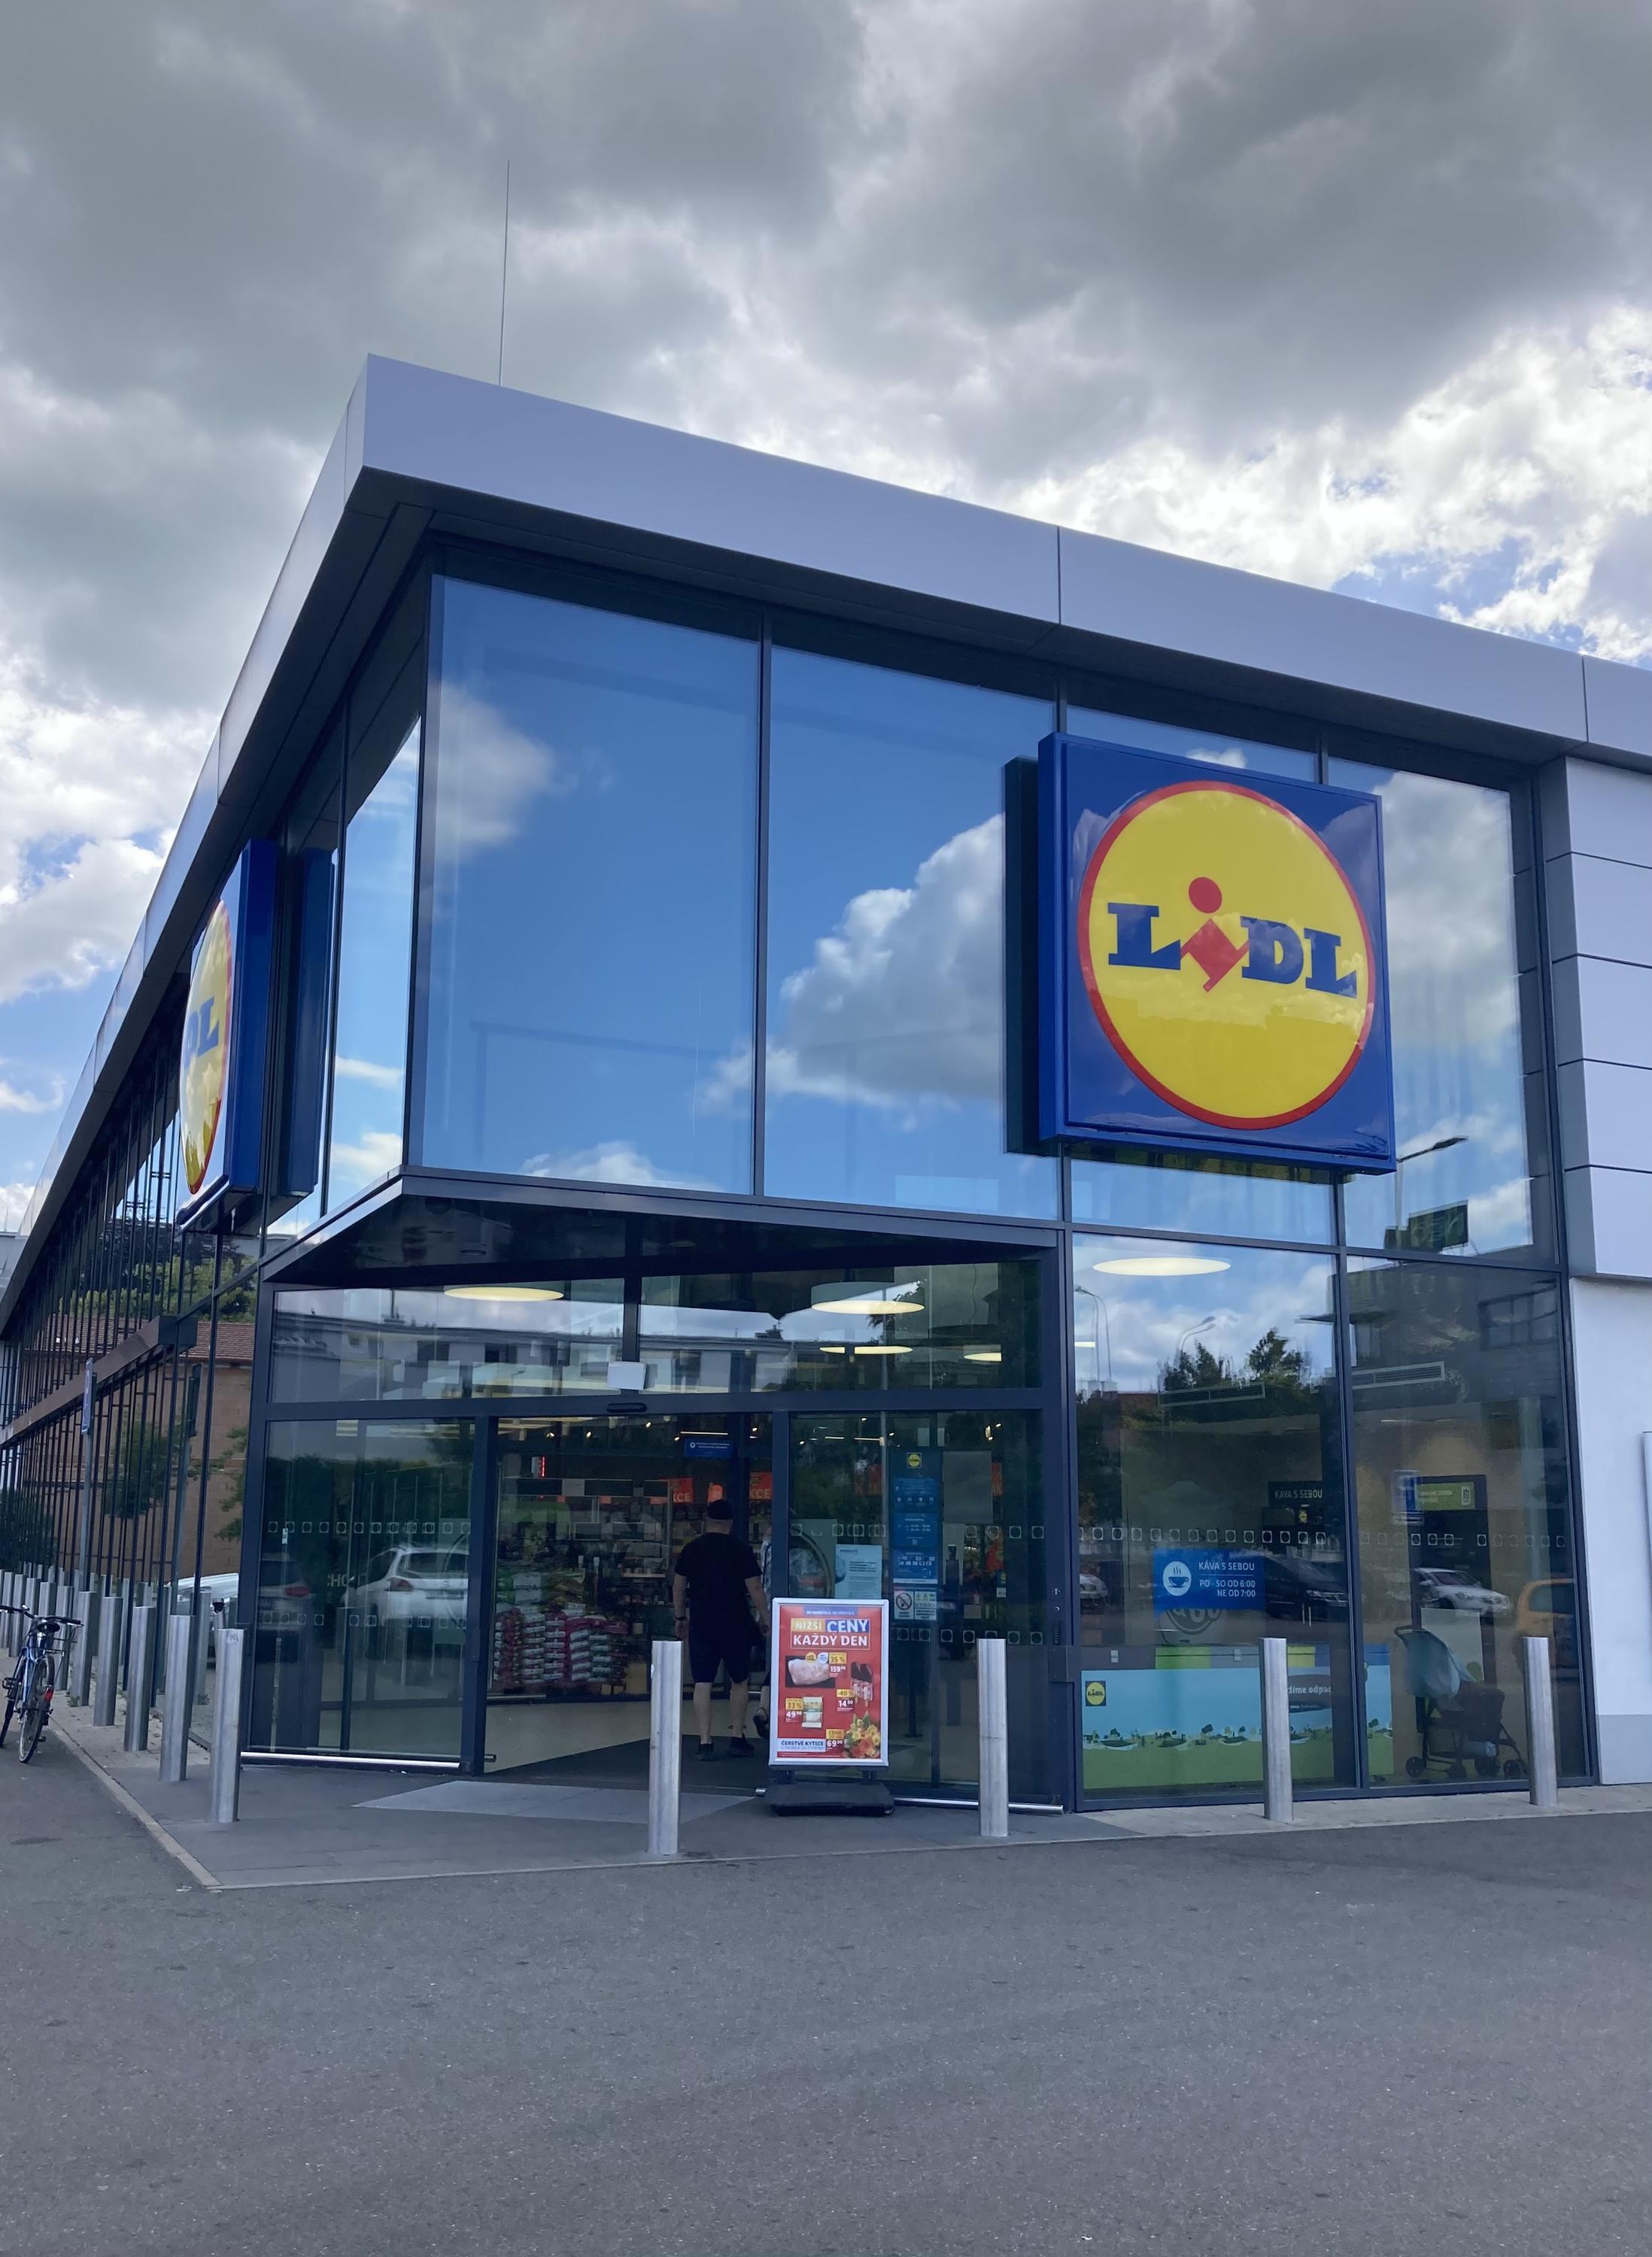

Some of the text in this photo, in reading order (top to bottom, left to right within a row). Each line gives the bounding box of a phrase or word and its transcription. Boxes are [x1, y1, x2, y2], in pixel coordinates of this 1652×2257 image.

[184, 995, 220, 1068] DL
[1221, 1562, 1227, 1570] S
[1228, 1562, 1255, 1571] SEBOU
[1199, 1579, 1210, 1587] PO
[1216, 1579, 1226, 1587] SO
[1241, 1589, 1256, 1597] 7:00
[828, 1619, 868, 1633] CENY
[793, 1633, 867, 1646] KAŽDÝ DEN
